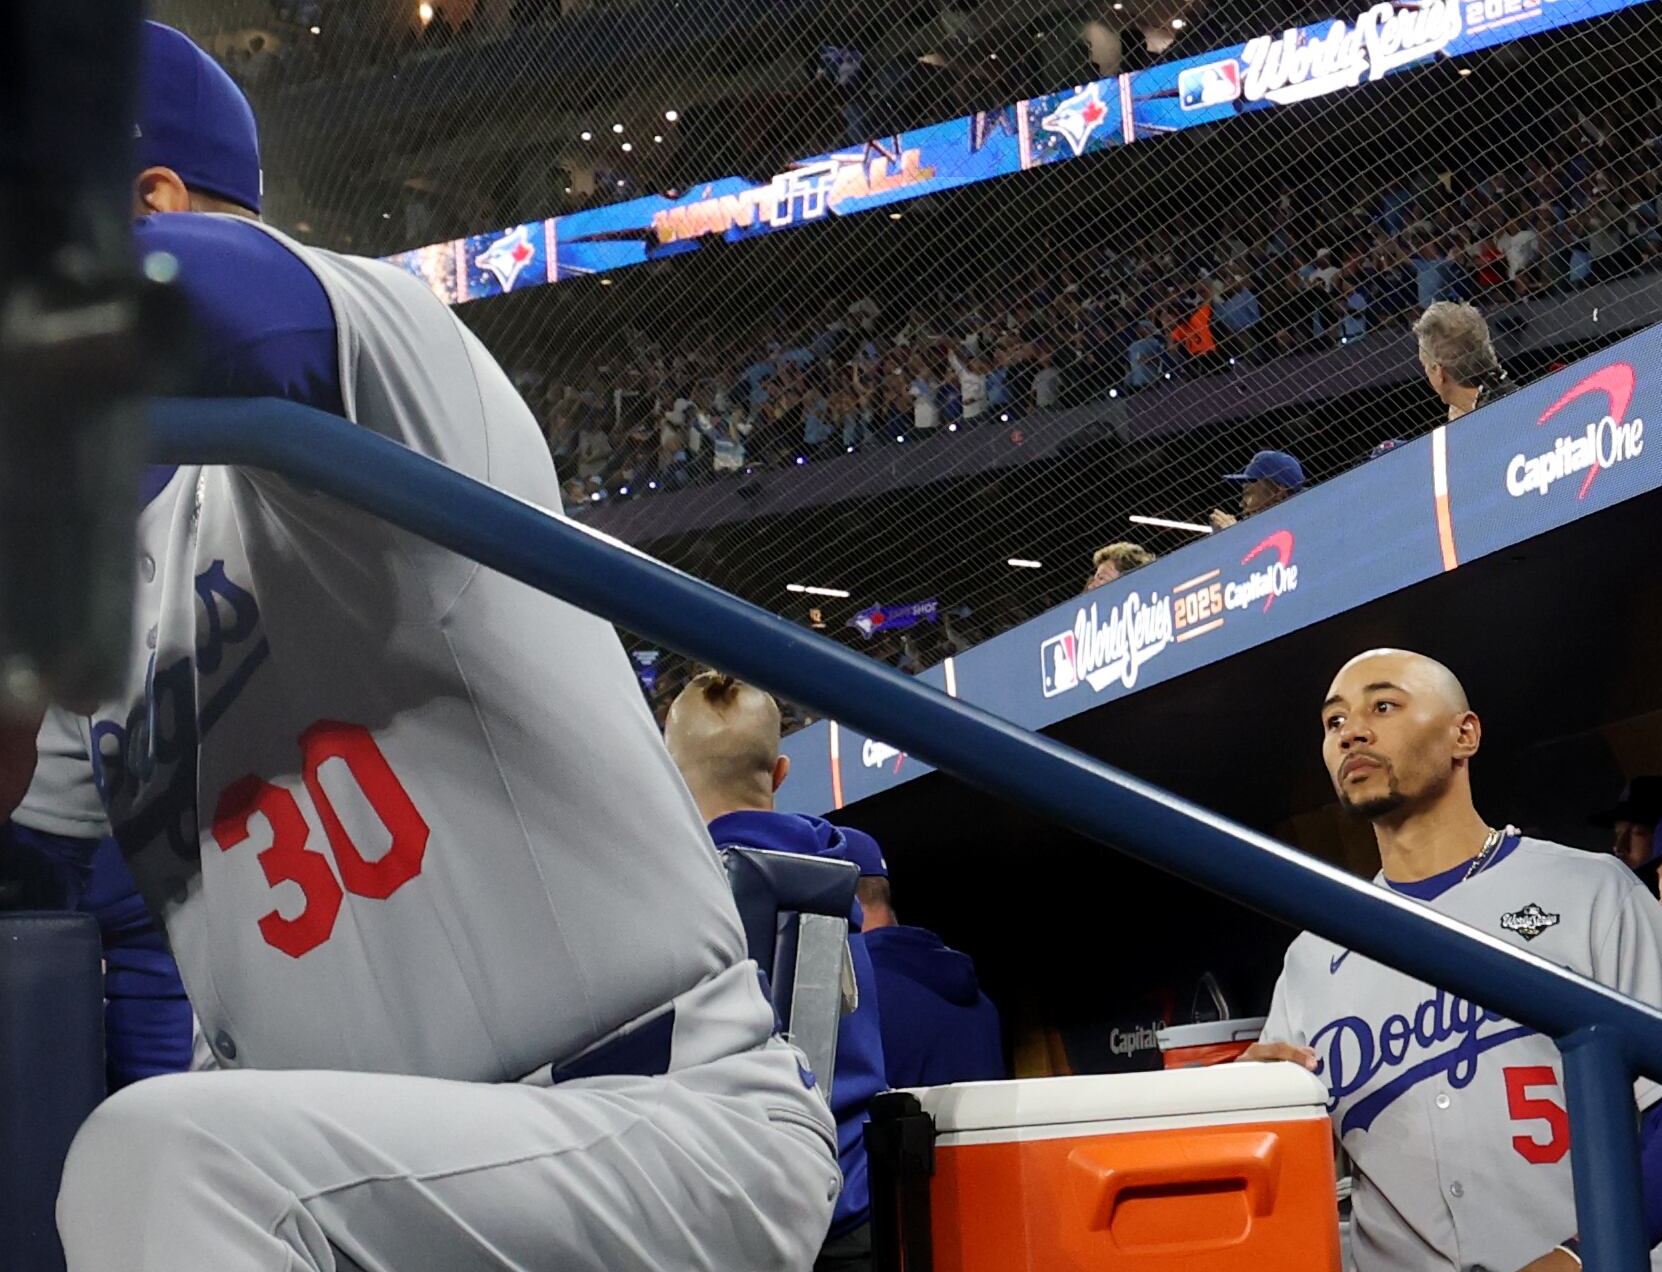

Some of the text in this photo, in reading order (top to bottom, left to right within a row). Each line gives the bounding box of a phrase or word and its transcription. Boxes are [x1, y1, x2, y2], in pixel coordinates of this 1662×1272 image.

[1241, 19, 1369, 105] World
[1075, 601, 1133, 692] World
[1121, 591, 1174, 688] Series
[1174, 582, 1223, 629] 2025
[212, 718, 430, 958] 30
[1310, 987, 1538, 1140] Dodg
[1503, 1065, 1571, 1164] 5
